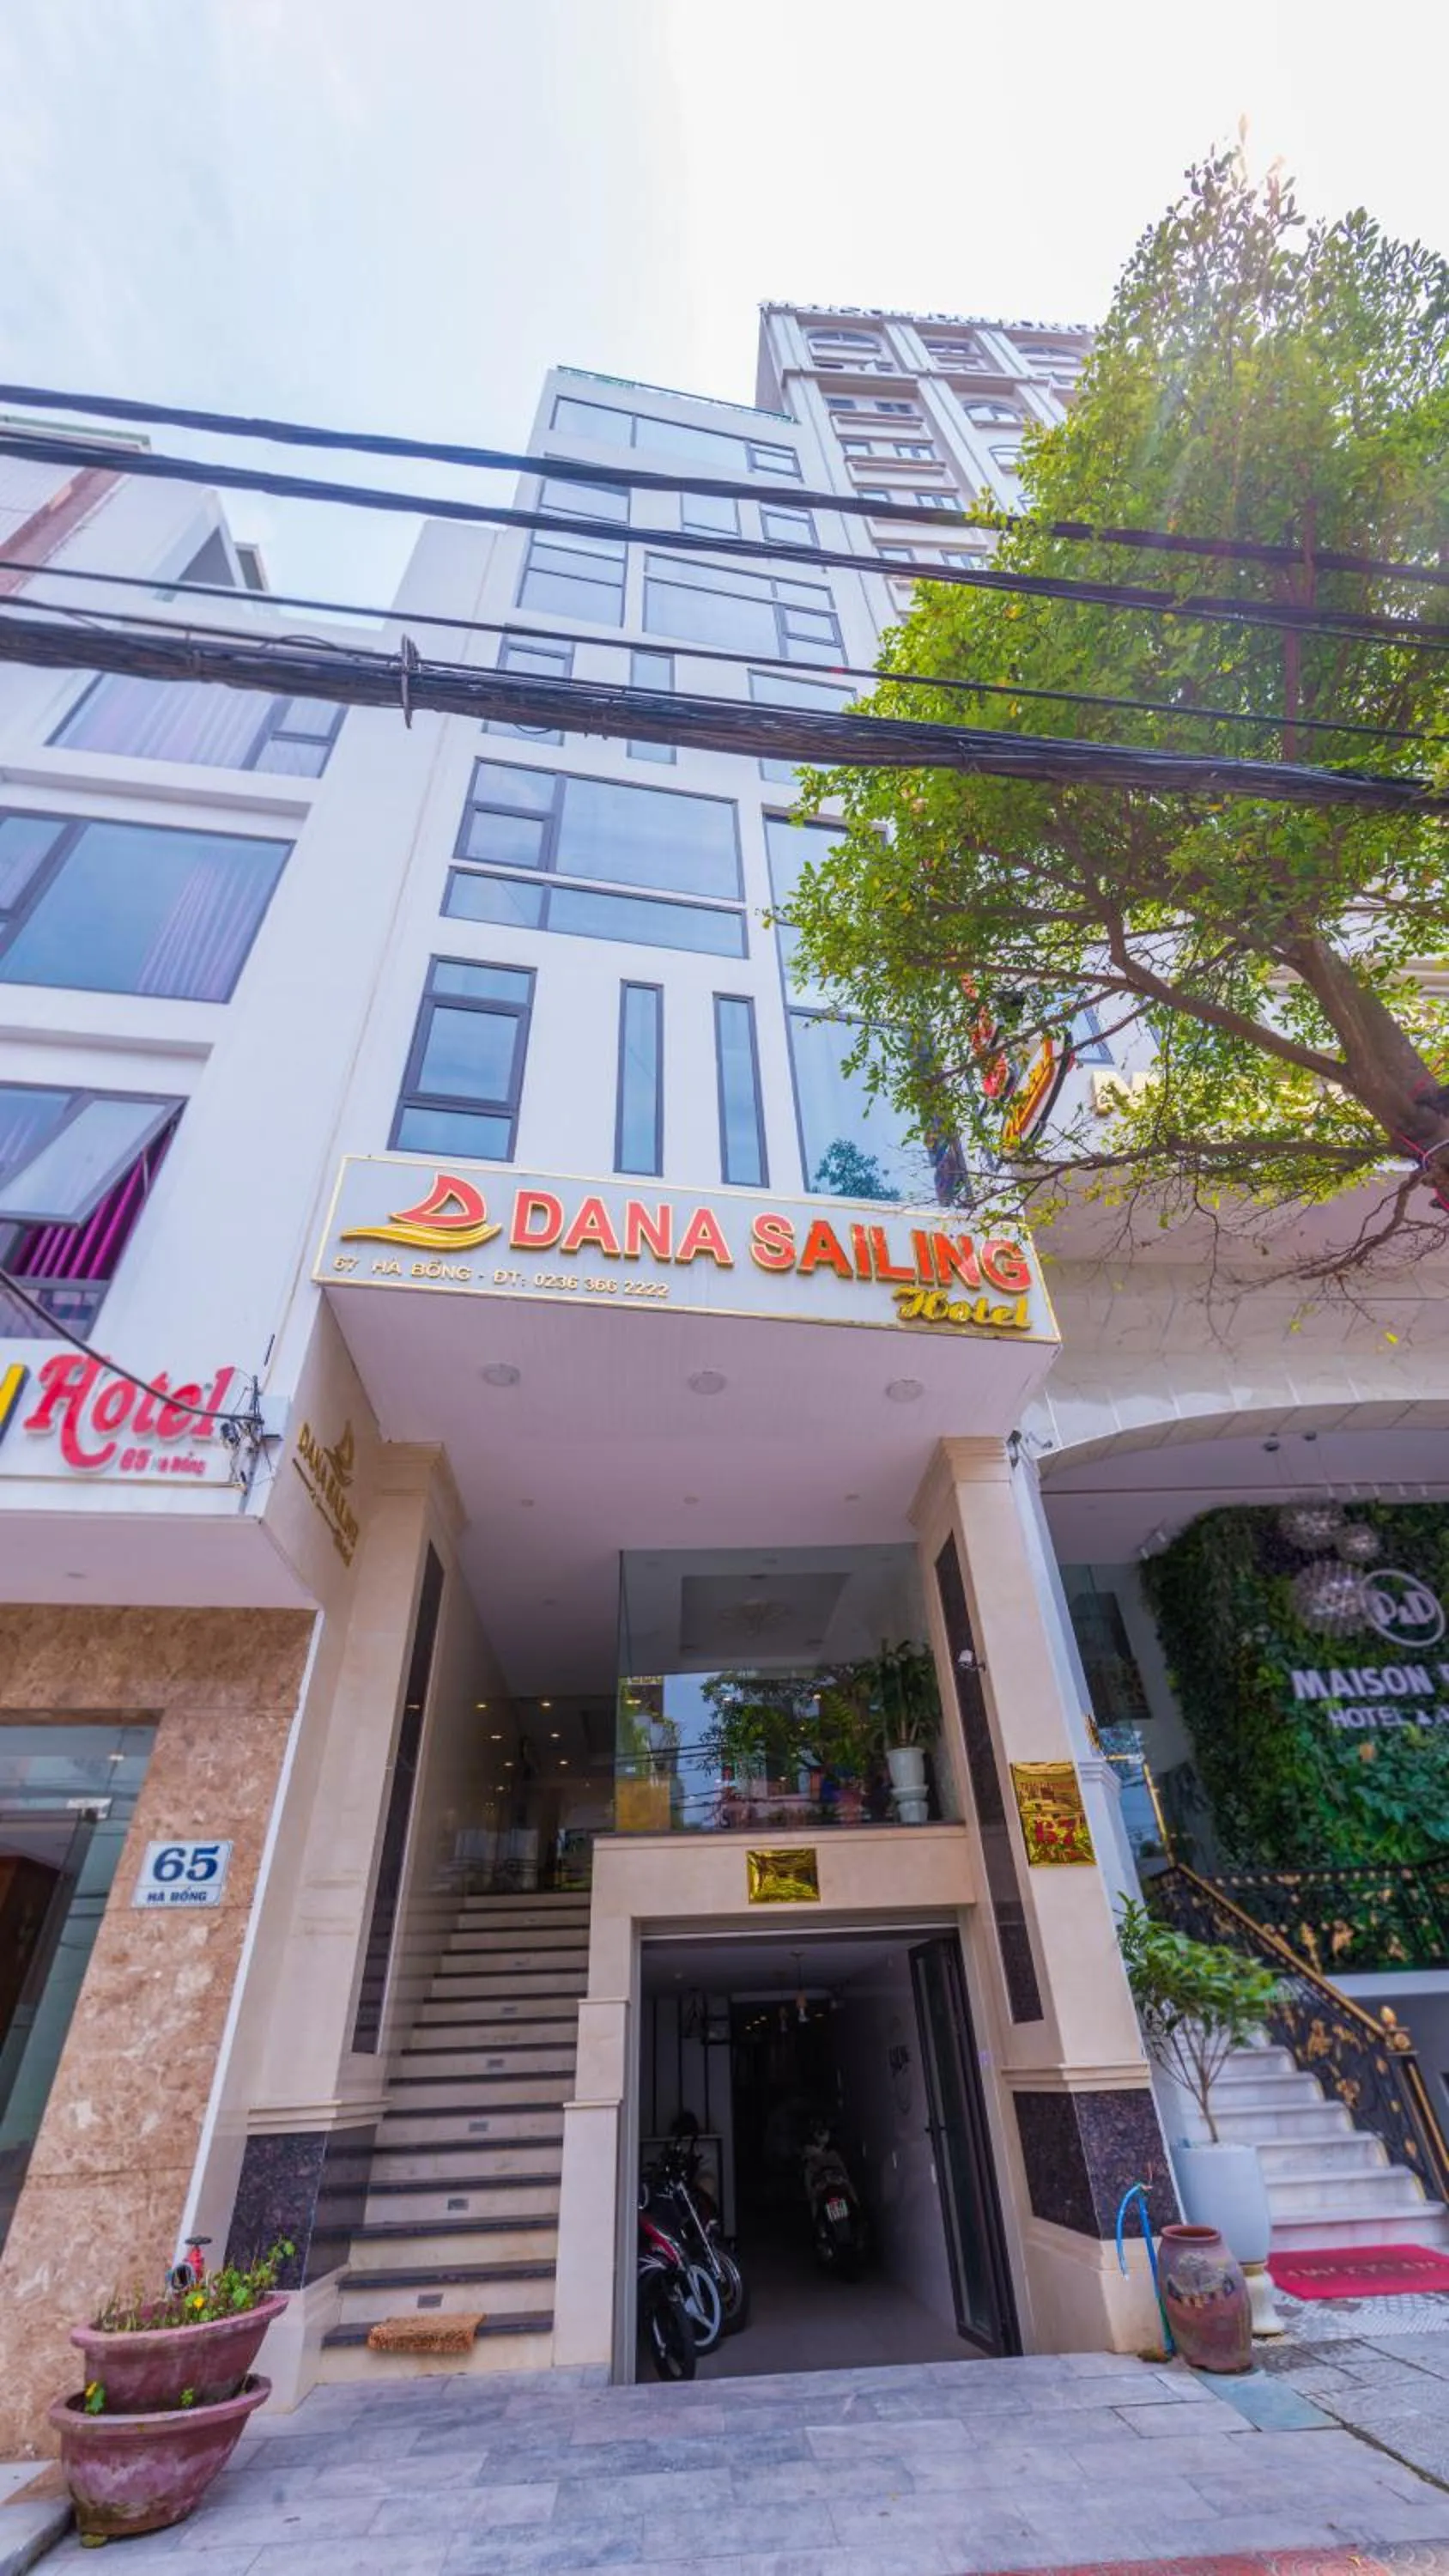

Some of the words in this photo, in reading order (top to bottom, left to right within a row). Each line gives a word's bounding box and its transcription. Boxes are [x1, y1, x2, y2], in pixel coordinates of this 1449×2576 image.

[509, 1188, 734, 1268] DANA
[750, 1212, 1033, 1294] SAILING
[623, 1279, 670, 1298] 2222
[893, 1284, 1032, 1330] Hotel
[23, 1352, 236, 1470] Hotel
[1291, 1664, 1435, 1699] MAISON
[1330, 1705, 1404, 1729] HOTEL
[153, 1845, 220, 1882] 65
